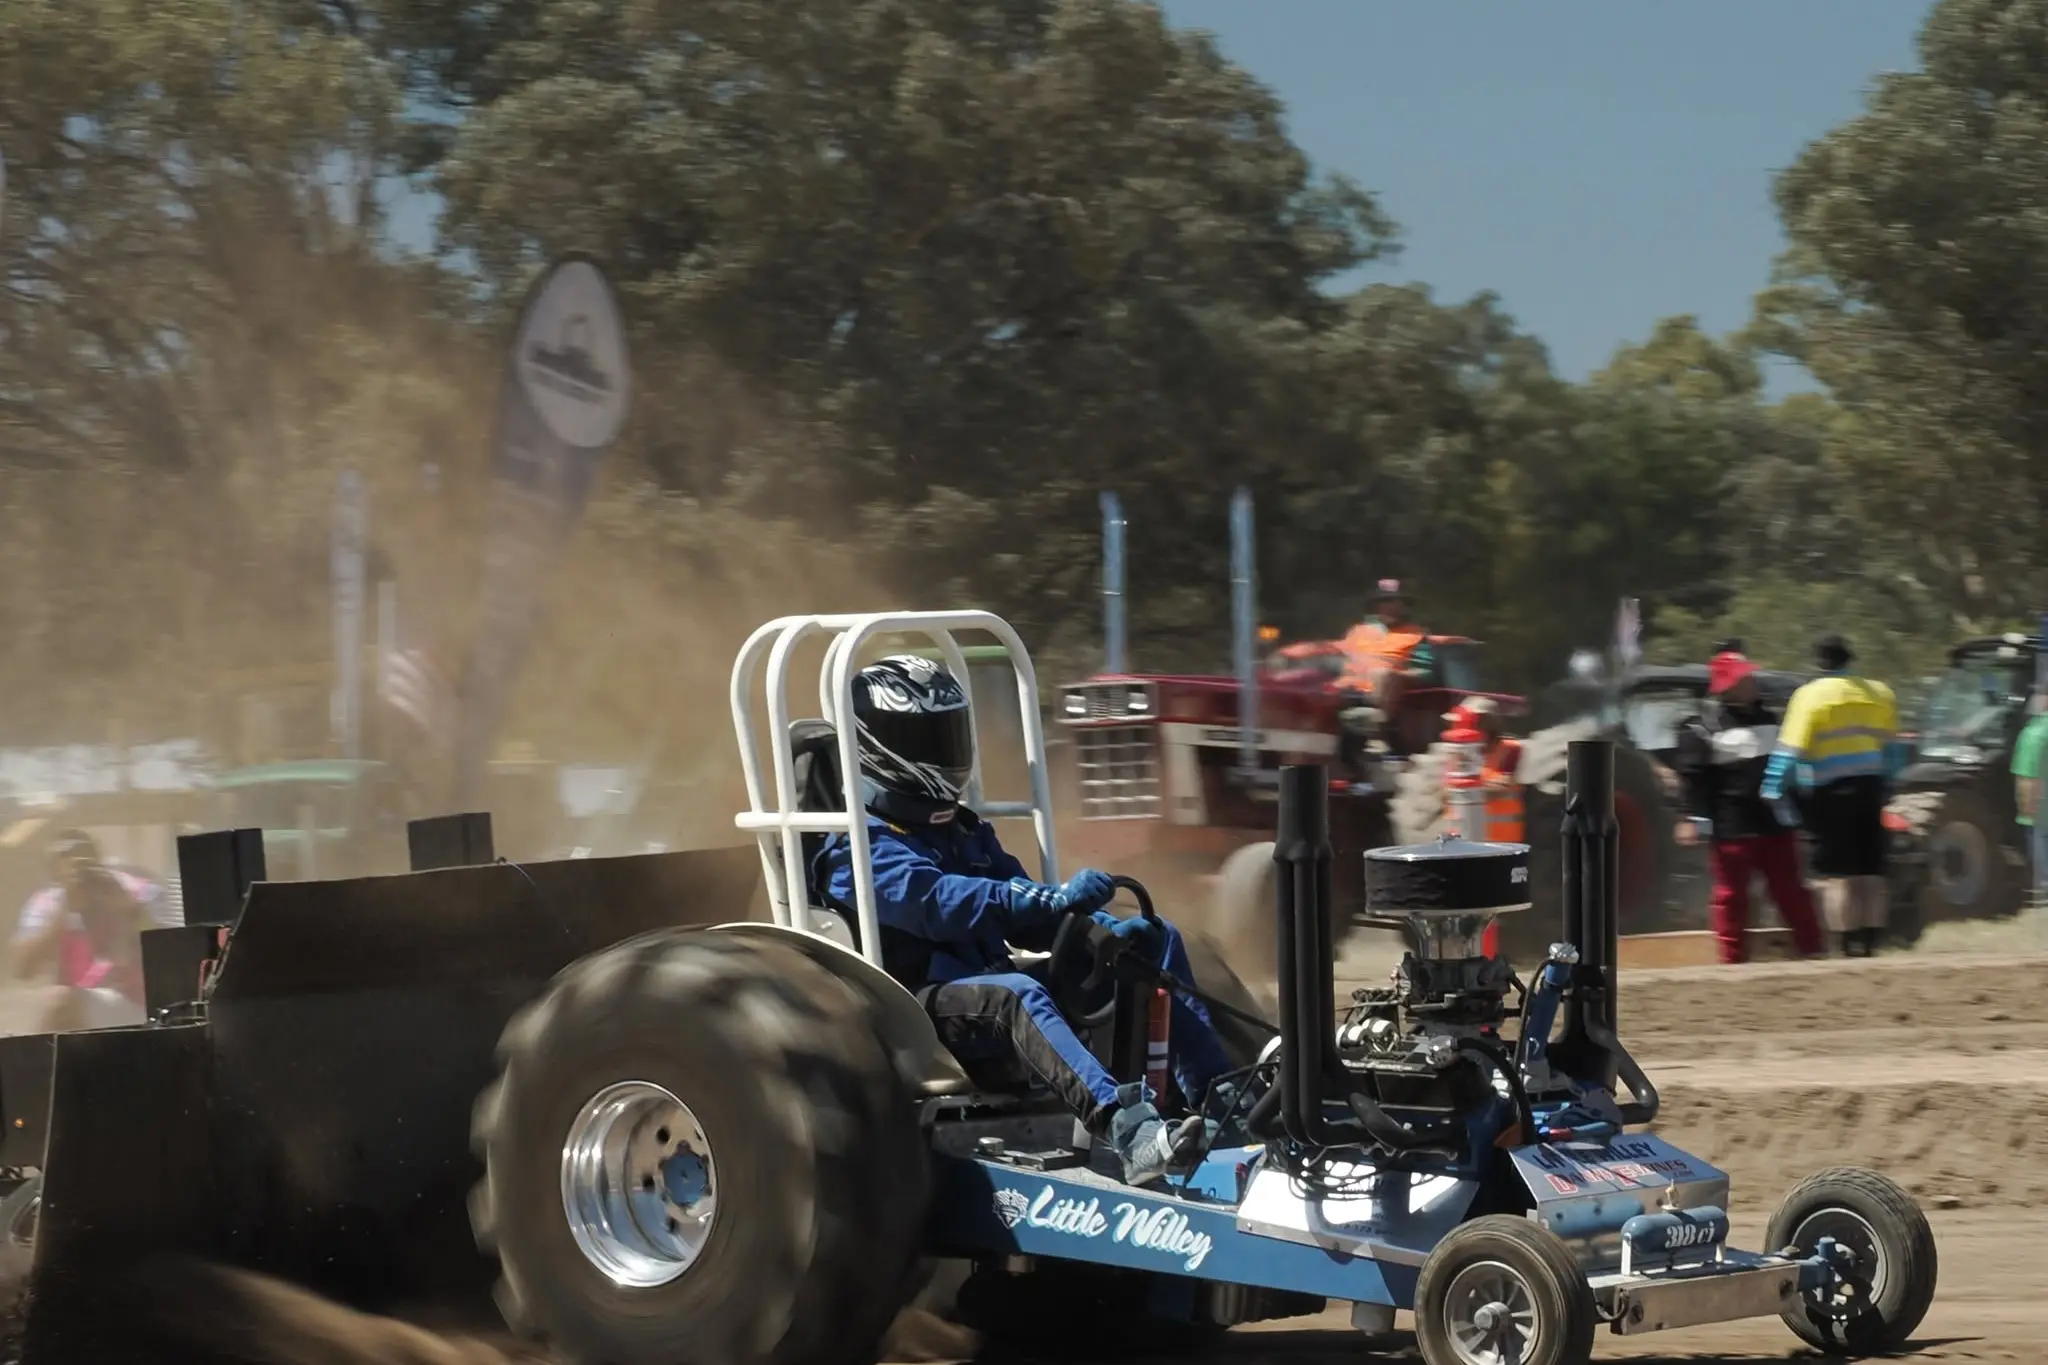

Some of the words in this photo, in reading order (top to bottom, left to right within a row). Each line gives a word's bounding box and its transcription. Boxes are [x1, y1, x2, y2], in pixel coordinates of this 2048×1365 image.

[1027, 1185, 1109, 1238] Little
[1112, 1202, 1213, 1272] Willey
[1665, 1223, 1697, 1249] 318
[1697, 1221, 1716, 1244] ci
